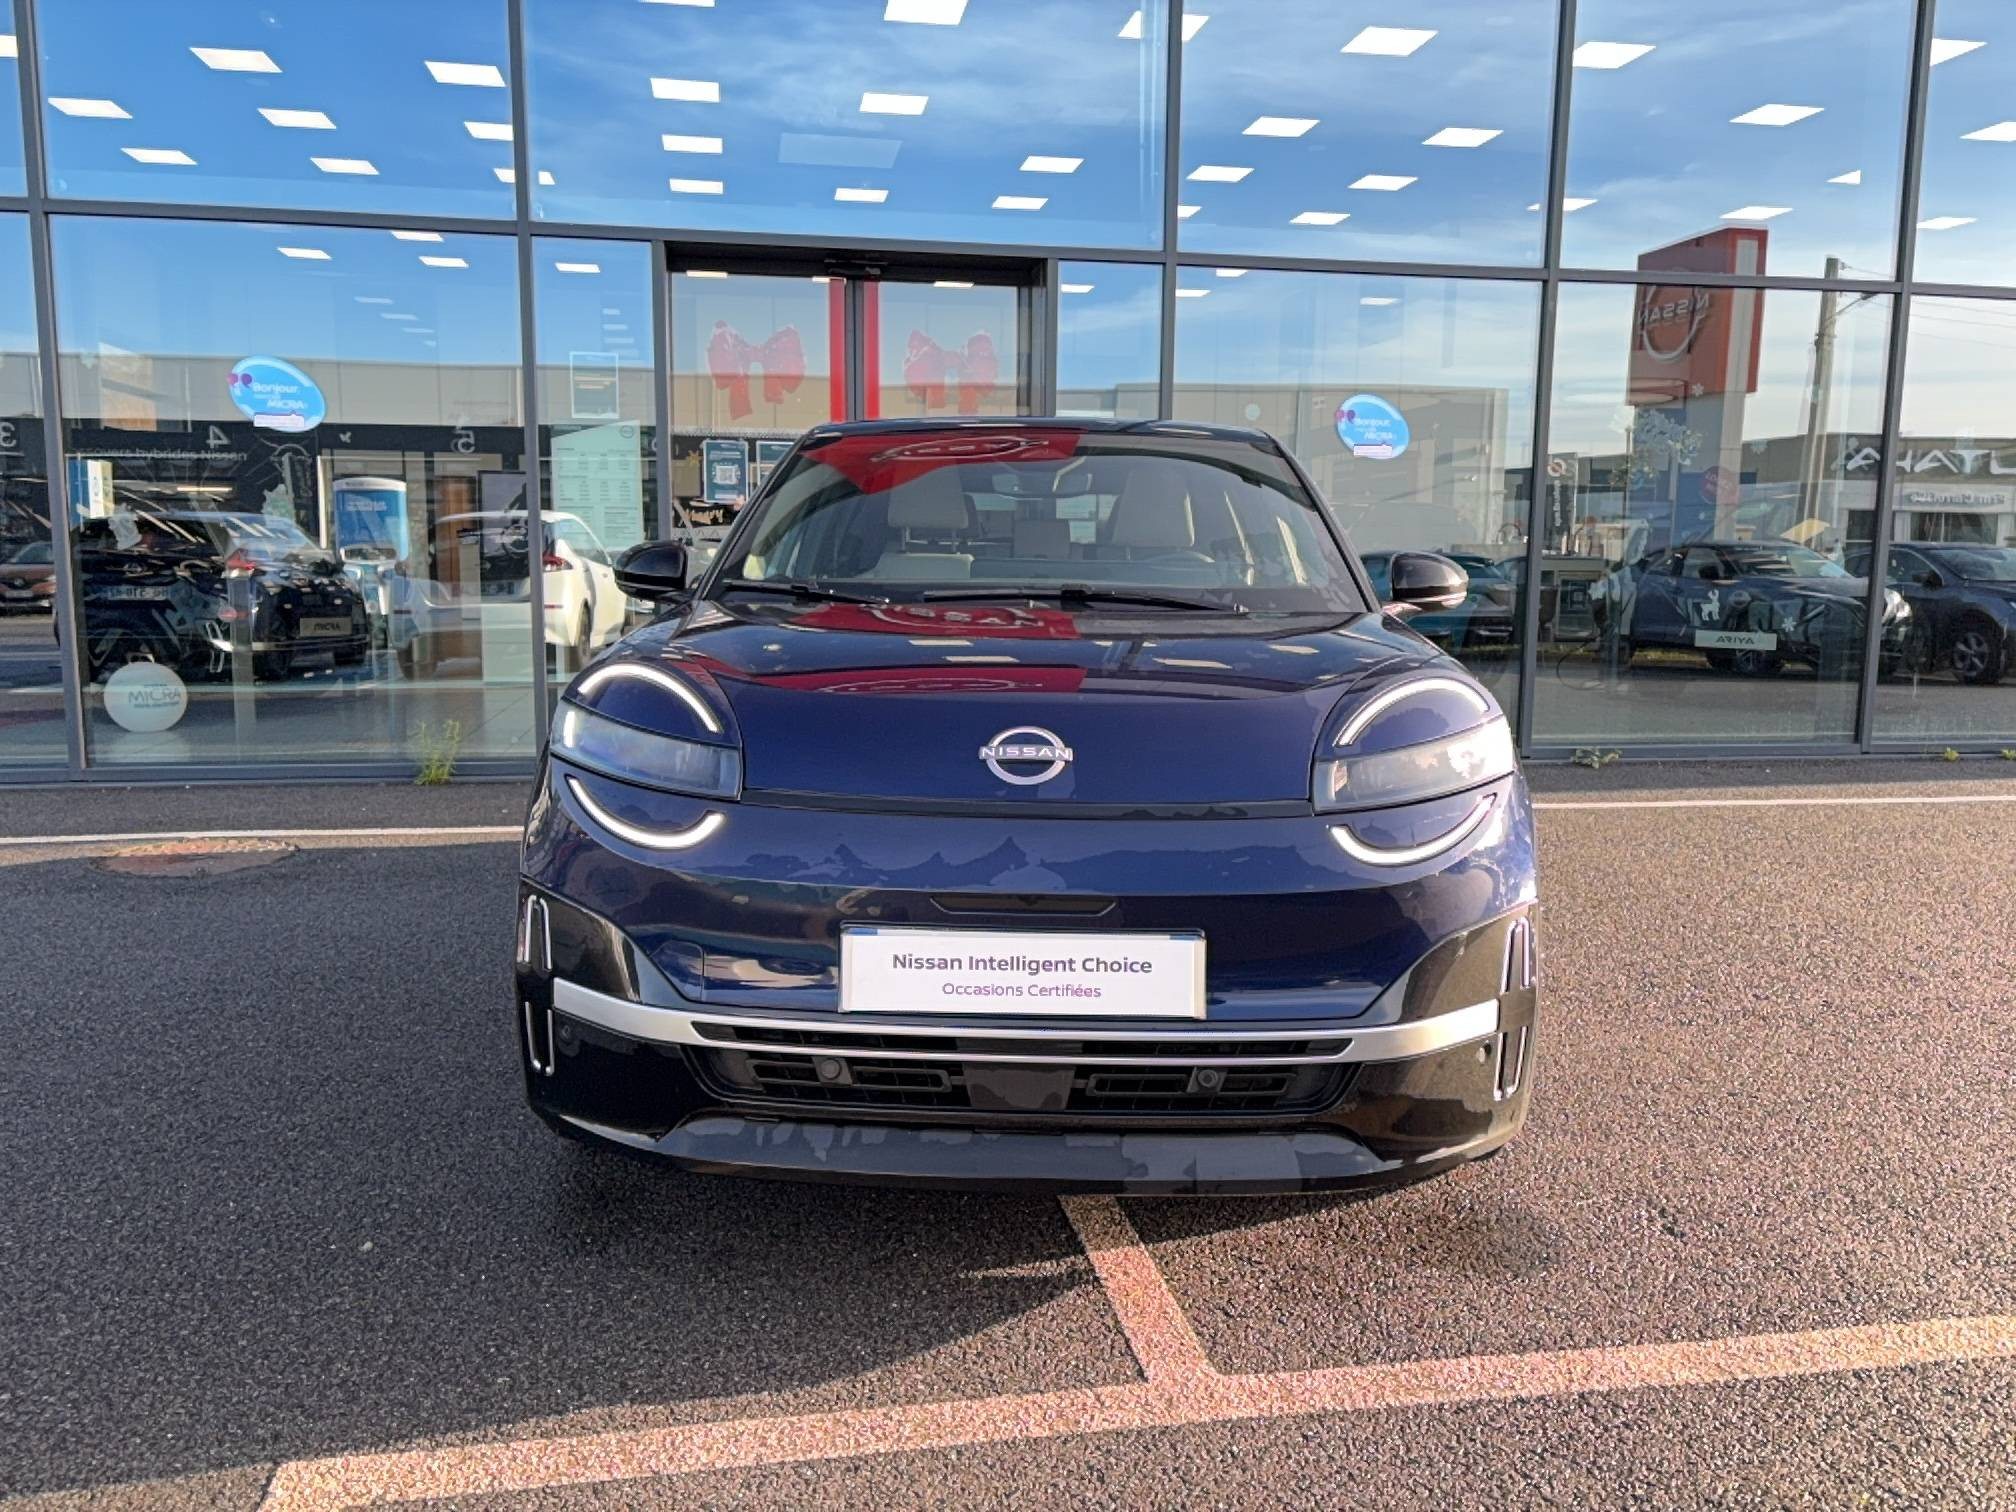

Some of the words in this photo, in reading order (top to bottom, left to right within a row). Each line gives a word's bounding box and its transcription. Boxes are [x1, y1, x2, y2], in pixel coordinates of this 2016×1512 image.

[253, 382, 299, 395] Bonjour
[1716, 635, 1755, 645] ARIYA
[981, 747, 1070, 759] NISSAN
[892, 954, 962, 971] Nissan
[968, 954, 1076, 976] Intelligent
[1082, 957, 1152, 973] Choice
[942, 983, 1023, 997] Occasions
[1028, 984, 1101, 998] Certifiées
